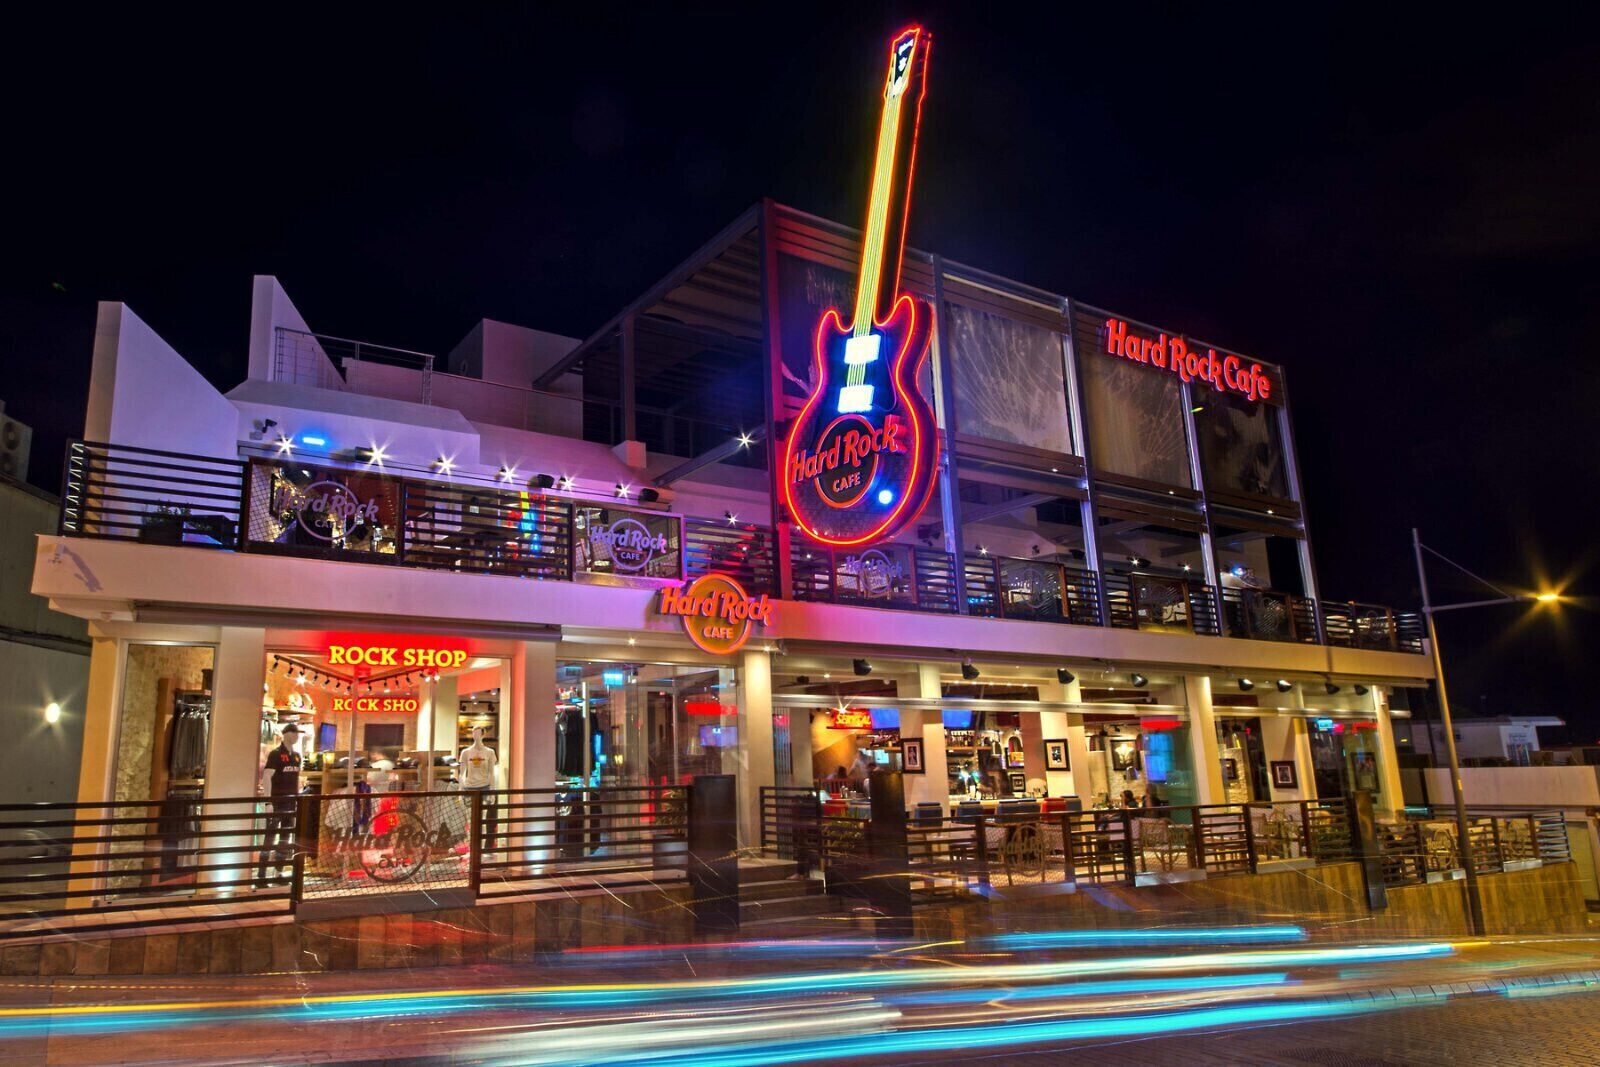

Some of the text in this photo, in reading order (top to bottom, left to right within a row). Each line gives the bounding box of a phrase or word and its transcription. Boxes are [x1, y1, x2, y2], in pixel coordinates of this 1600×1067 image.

[1106, 318, 1167, 368] Hard
[1169, 336, 1225, 392] Rock
[790, 421, 901, 483] Hard Rock
[832, 471, 861, 493] CAFE
[274, 486, 379, 522] Hard Rock
[590, 526, 667, 554] Hard Rock
[620, 551, 641, 561] CAFE
[660, 586, 775, 627] Hard Rock
[703, 626, 734, 640] CAFE
[328, 645, 467, 668] ROCK SHOP
